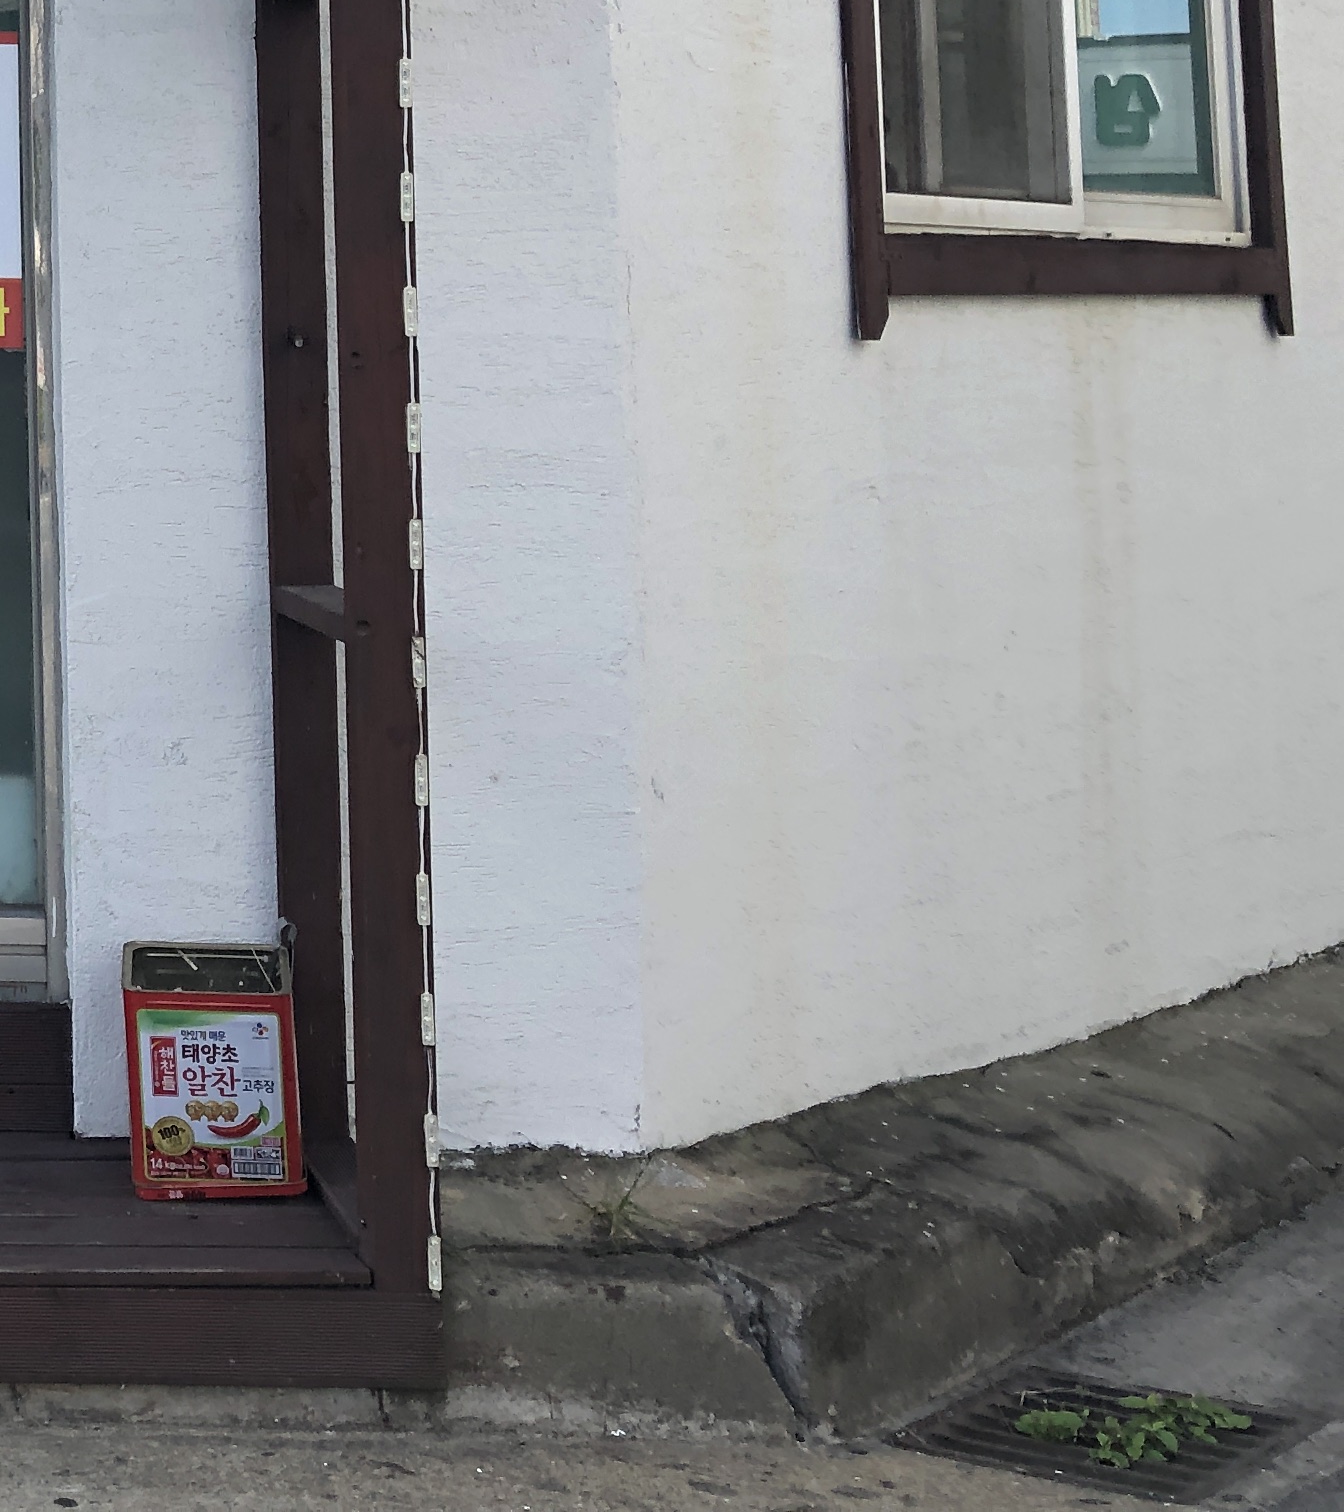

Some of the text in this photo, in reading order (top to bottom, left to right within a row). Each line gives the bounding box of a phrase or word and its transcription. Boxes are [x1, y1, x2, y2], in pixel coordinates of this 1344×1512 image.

[181, 1043, 239, 1064] 태양초
[182, 1065, 241, 1097] 알찬
[243, 1080, 275, 1094] 고추장
